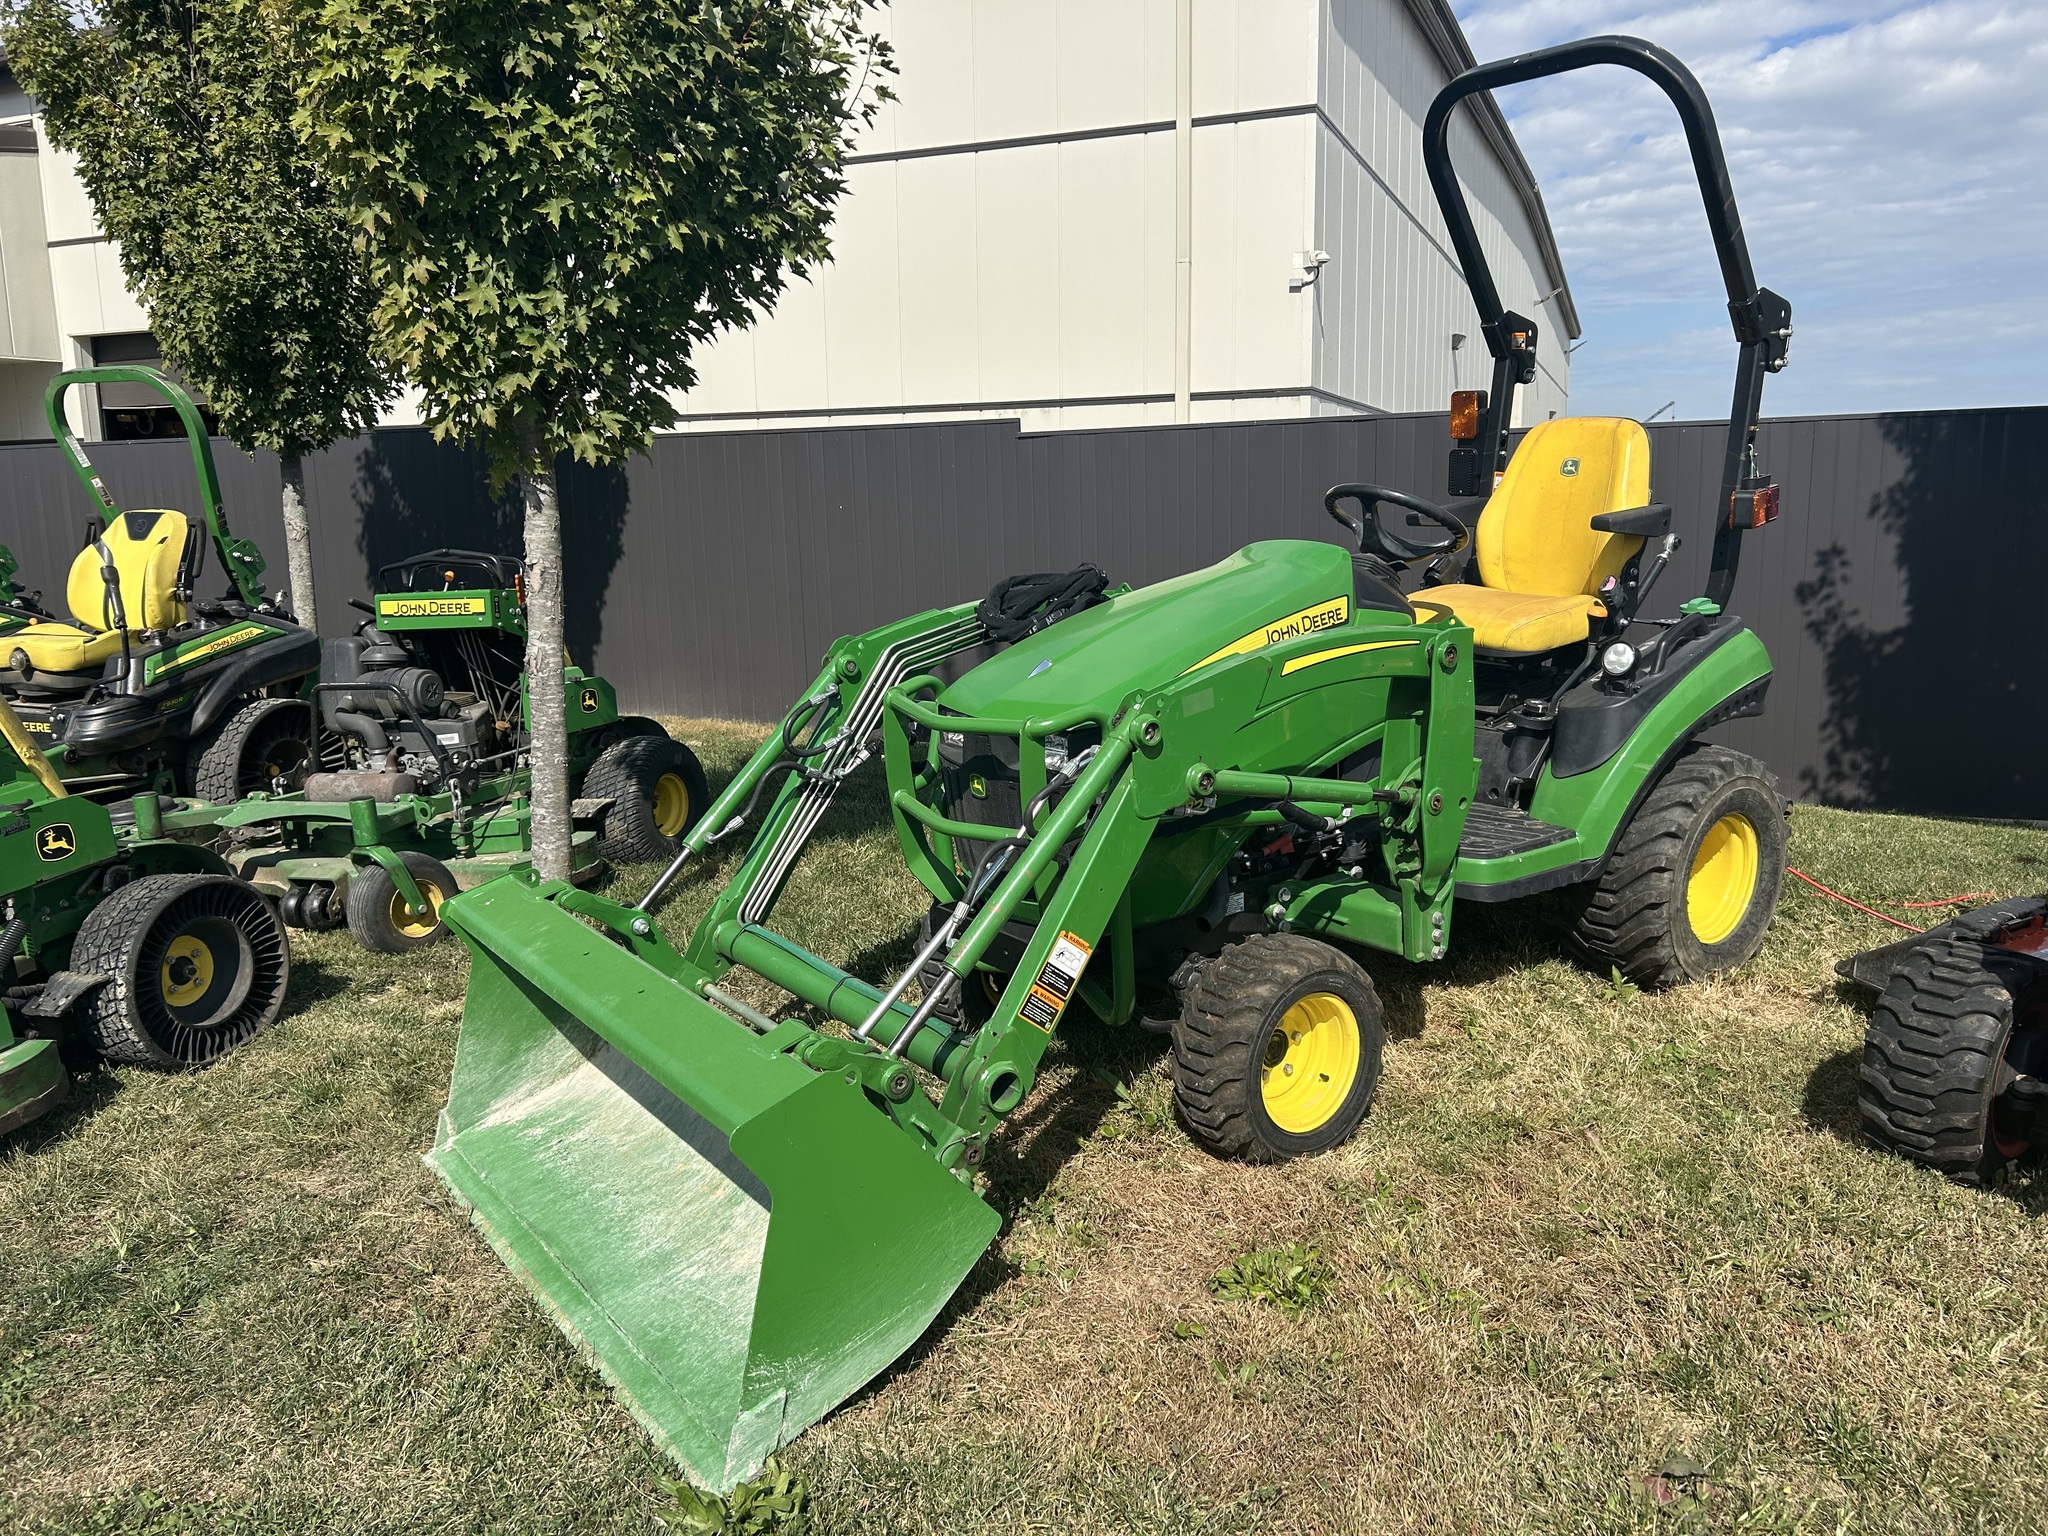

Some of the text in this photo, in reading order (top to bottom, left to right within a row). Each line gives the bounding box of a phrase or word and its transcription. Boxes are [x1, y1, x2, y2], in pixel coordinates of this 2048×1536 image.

[393, 601, 471, 614] JOHN DEERE
[1266, 607, 1344, 645] JOHN DEERE
[209, 629, 255, 652] JOHN DEERE
[22, 721, 52, 733] EERE
[1069, 934, 1089, 952] WARNING
[1039, 992, 1060, 1008] WARNING
